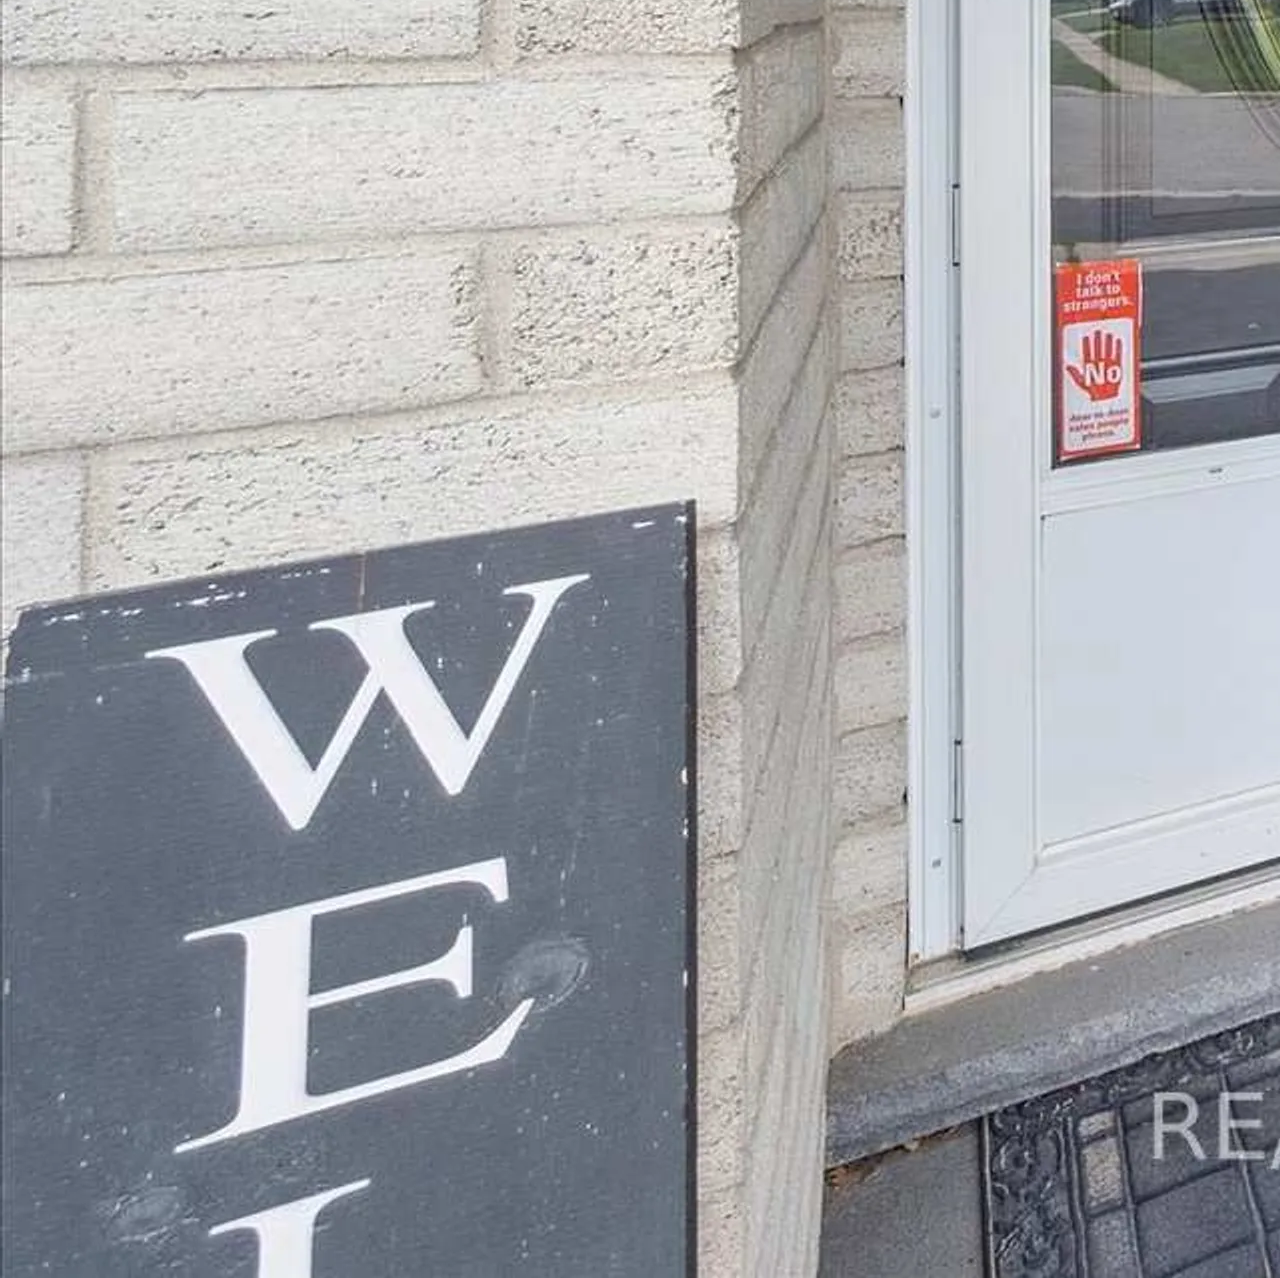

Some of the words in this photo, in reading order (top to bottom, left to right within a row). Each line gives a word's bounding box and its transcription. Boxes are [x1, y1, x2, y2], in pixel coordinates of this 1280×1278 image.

[1076, 273, 1083, 286] I
[1105, 283, 1121, 295] to
[1085, 362, 1122, 387] No
